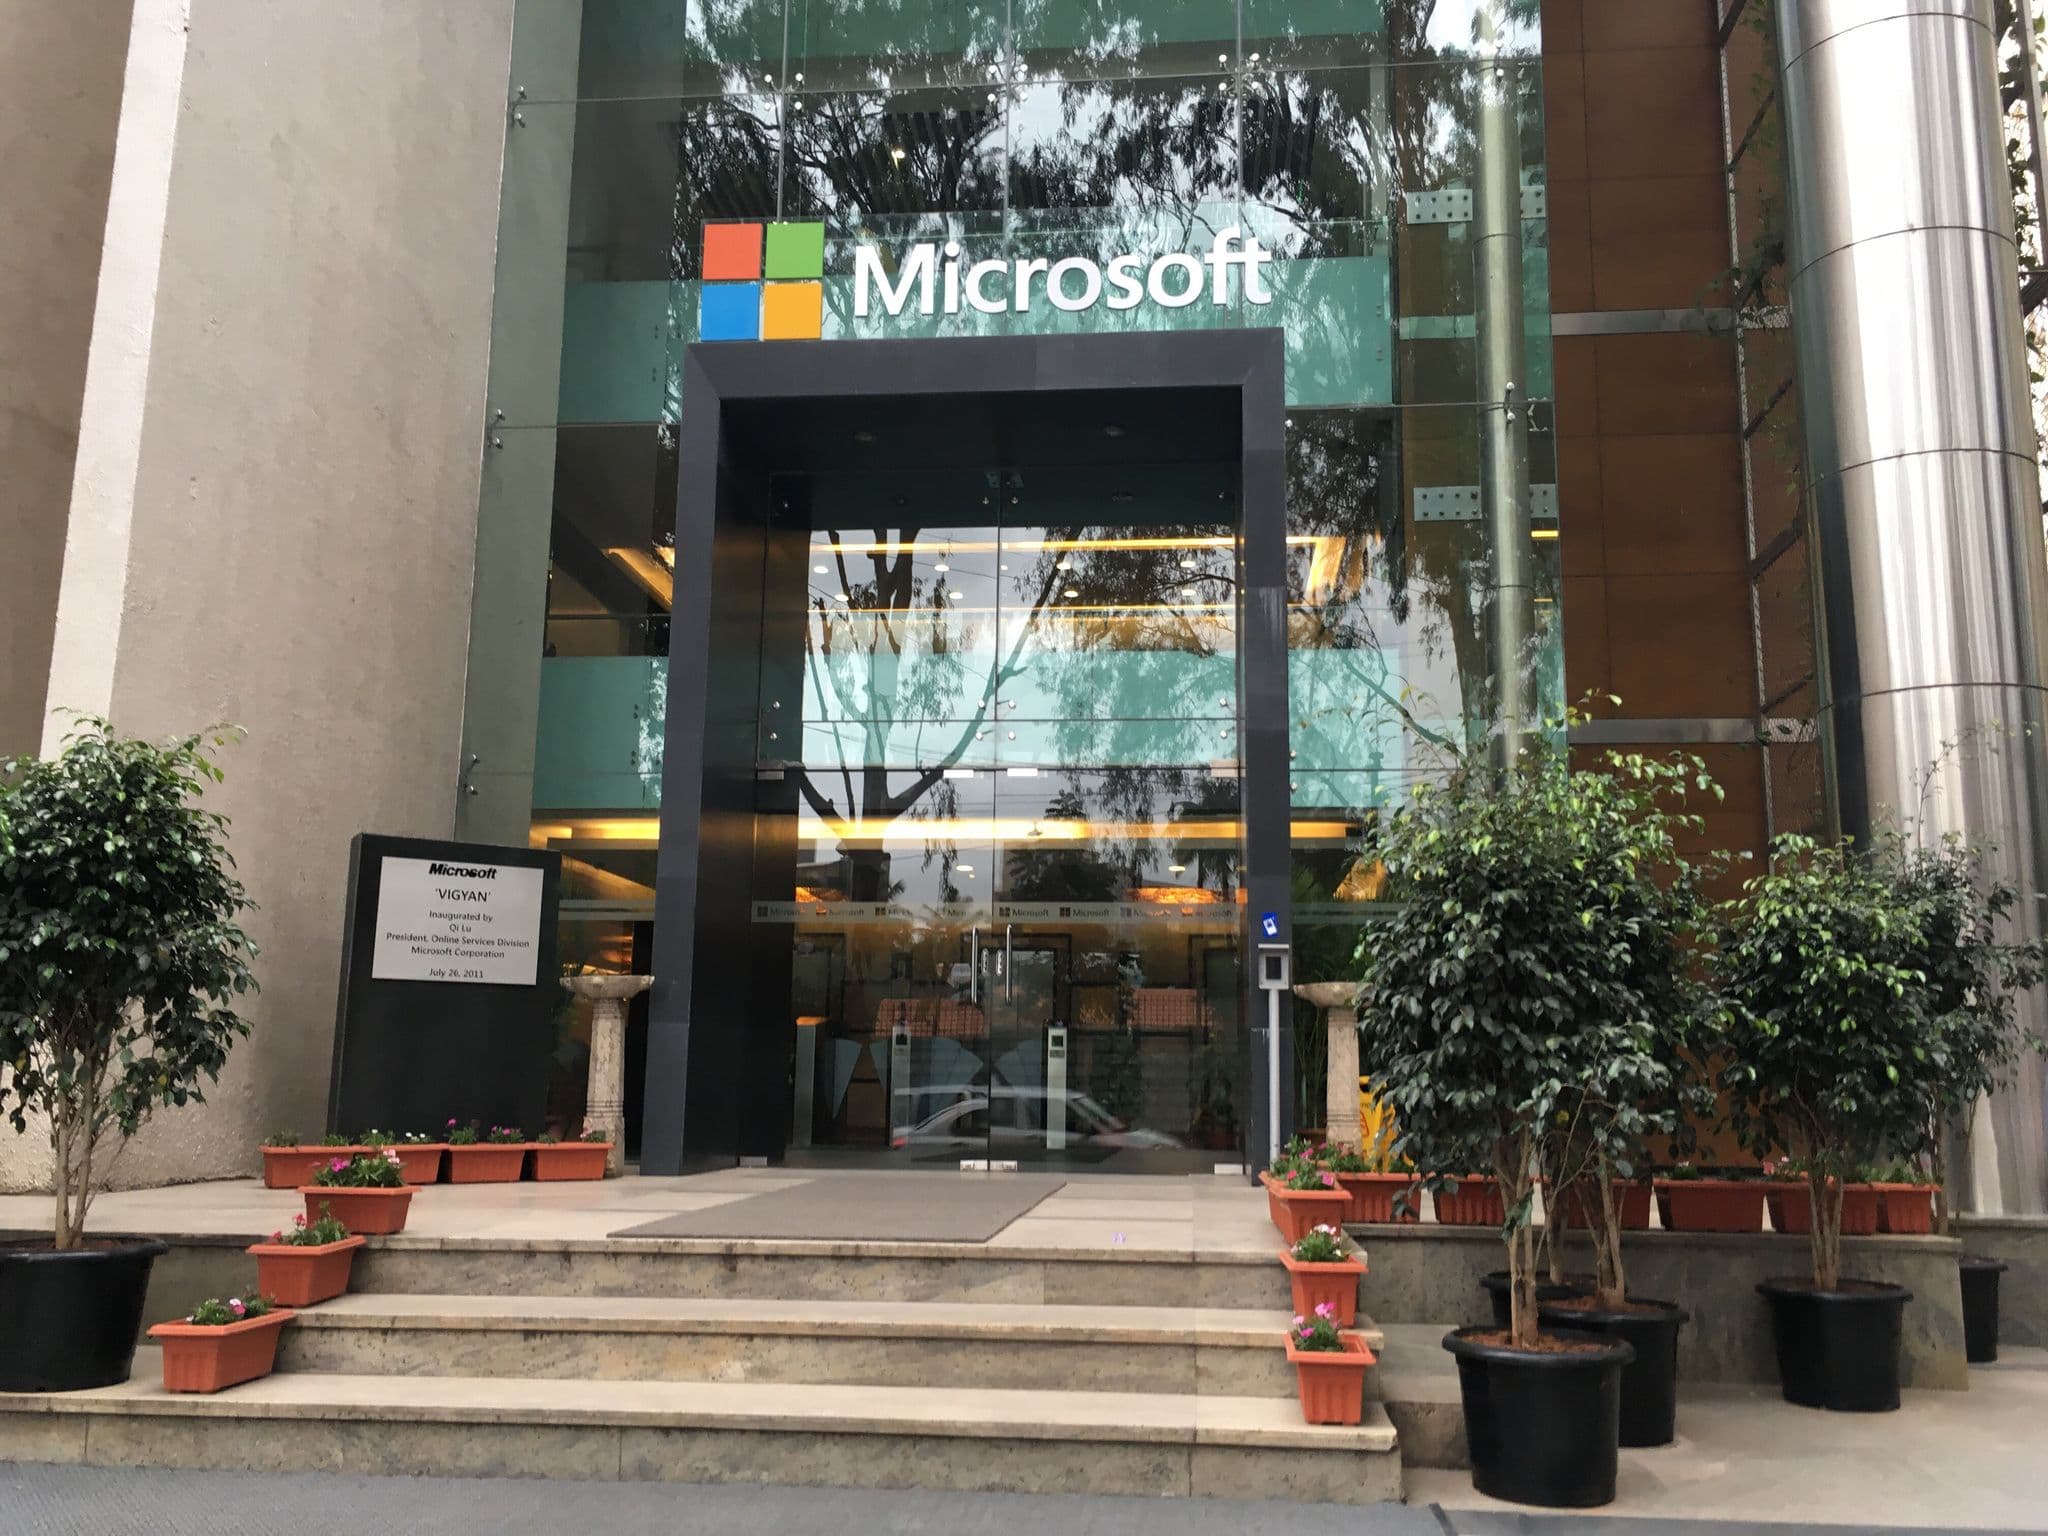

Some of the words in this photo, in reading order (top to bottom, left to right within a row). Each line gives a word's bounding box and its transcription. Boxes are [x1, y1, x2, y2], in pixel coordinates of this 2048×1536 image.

[854, 226, 1273, 318] Microsoft
[429, 863, 498, 880] Microsoft
[429, 909, 481, 921] Inaugurated
[482, 913, 493, 923] by
[1012, 907, 1049, 917] Microsoft
[1072, 907, 1110, 917] Microsoft
[449, 923, 459, 933] Qi
[461, 924, 472, 933] Lu
[431, 934, 460, 944] Online
[461, 936, 495, 946] Services
[497, 938, 530, 948] Division
[411, 946, 452, 956] Microsoft
[454, 948, 505, 958] Corporation
[429, 967, 446, 978] July
[463, 969, 484, 979] 2011
